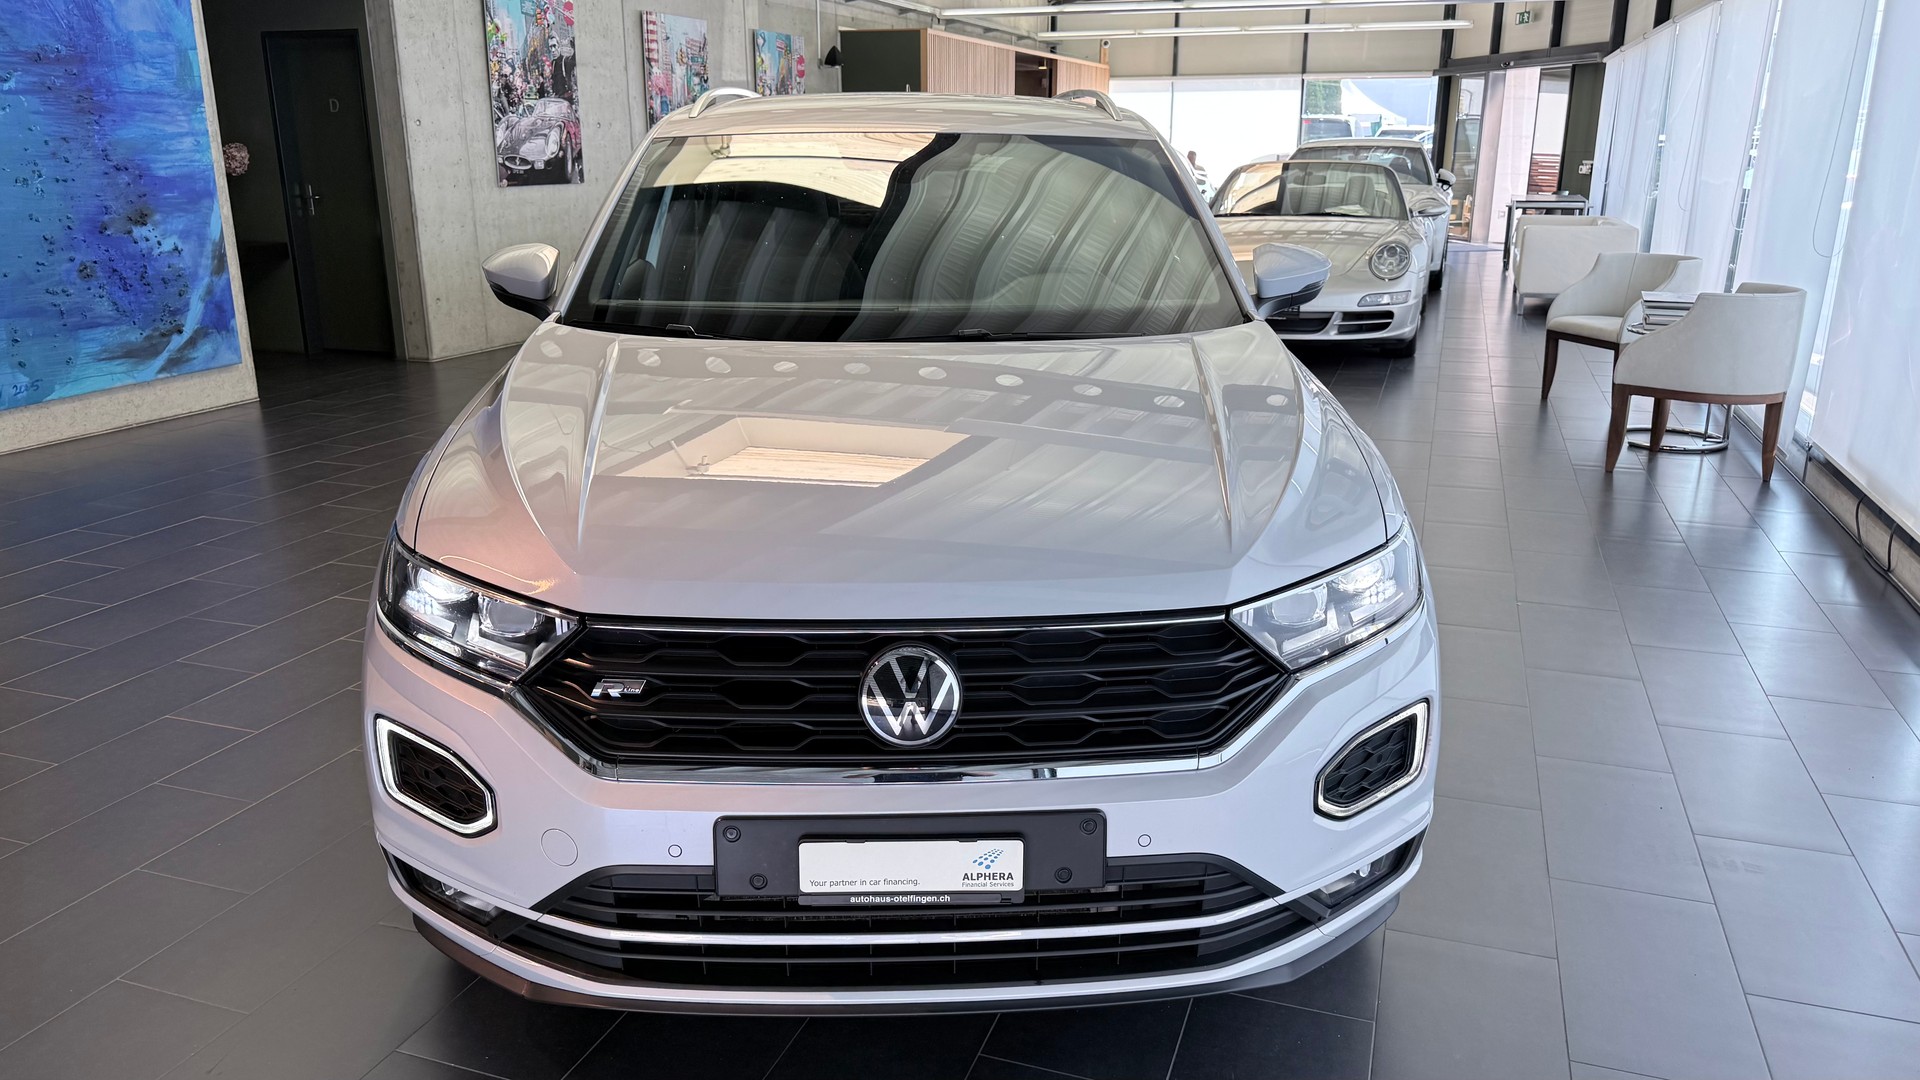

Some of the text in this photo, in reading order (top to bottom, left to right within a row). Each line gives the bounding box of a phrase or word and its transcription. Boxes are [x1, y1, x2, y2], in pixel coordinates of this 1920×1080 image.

[329, 98, 340, 113] D
[590, 681, 625, 698] R
[864, 650, 956, 738] VW
[809, 879, 827, 887] Your
[829, 879, 857, 888] partner
[859, 878, 867, 886] in
[883, 877, 921, 887] financing.
[962, 872, 1014, 882] ALPHERA
[850, 894, 951, 904] autohaus-otelfingen.ch
